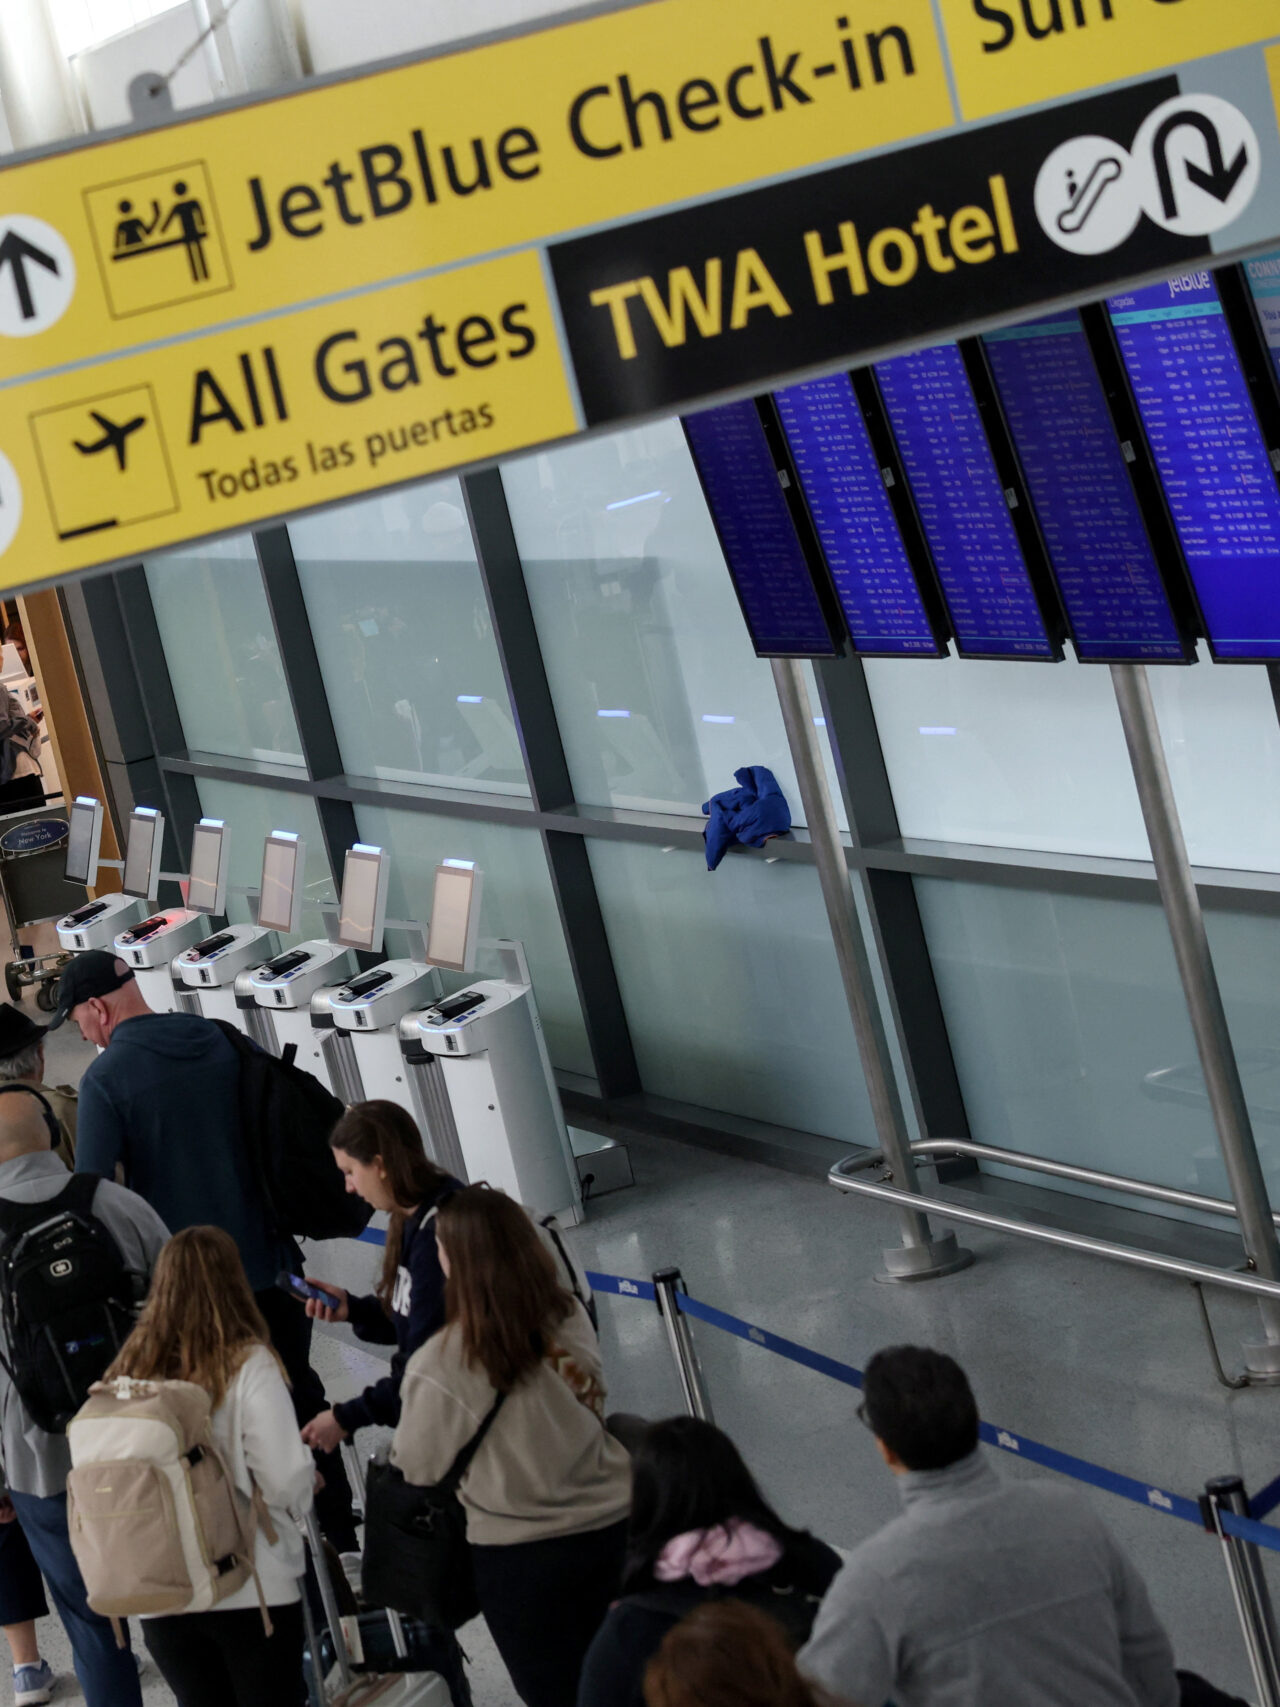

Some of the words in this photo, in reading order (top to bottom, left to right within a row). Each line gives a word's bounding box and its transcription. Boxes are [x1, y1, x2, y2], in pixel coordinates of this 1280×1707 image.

[247, 126, 541, 253] JetBlue
[568, 15, 916, 160] Check-in
[589, 246, 793, 360] TWA
[803, 173, 1019, 307] Hotel
[188, 345, 289, 446] All
[313, 301, 537, 406] Gates
[198, 457, 299, 503] Todas
[306, 441, 357, 475] las
[365, 402, 496, 468] puertas
[18, 837, 34, 846] New
[34, 831, 52, 840] York
